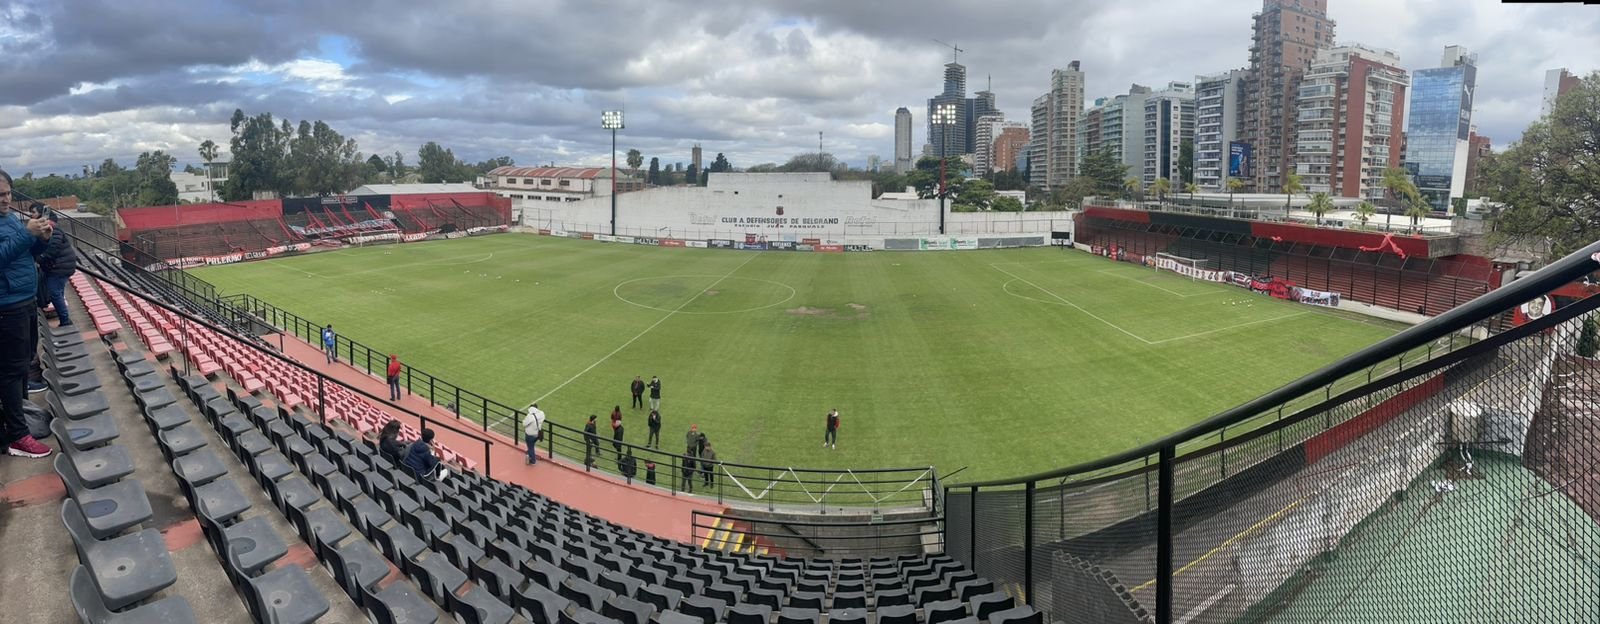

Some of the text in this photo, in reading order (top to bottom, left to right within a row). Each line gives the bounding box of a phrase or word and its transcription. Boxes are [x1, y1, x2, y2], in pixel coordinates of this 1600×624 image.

[721, 216, 738, 224] CLUB
[746, 217, 788, 225] DEFENSORES
[791, 217, 799, 225] DE
[802, 217, 839, 225] BELGRANO
[205, 254, 243, 265] PALERMO
